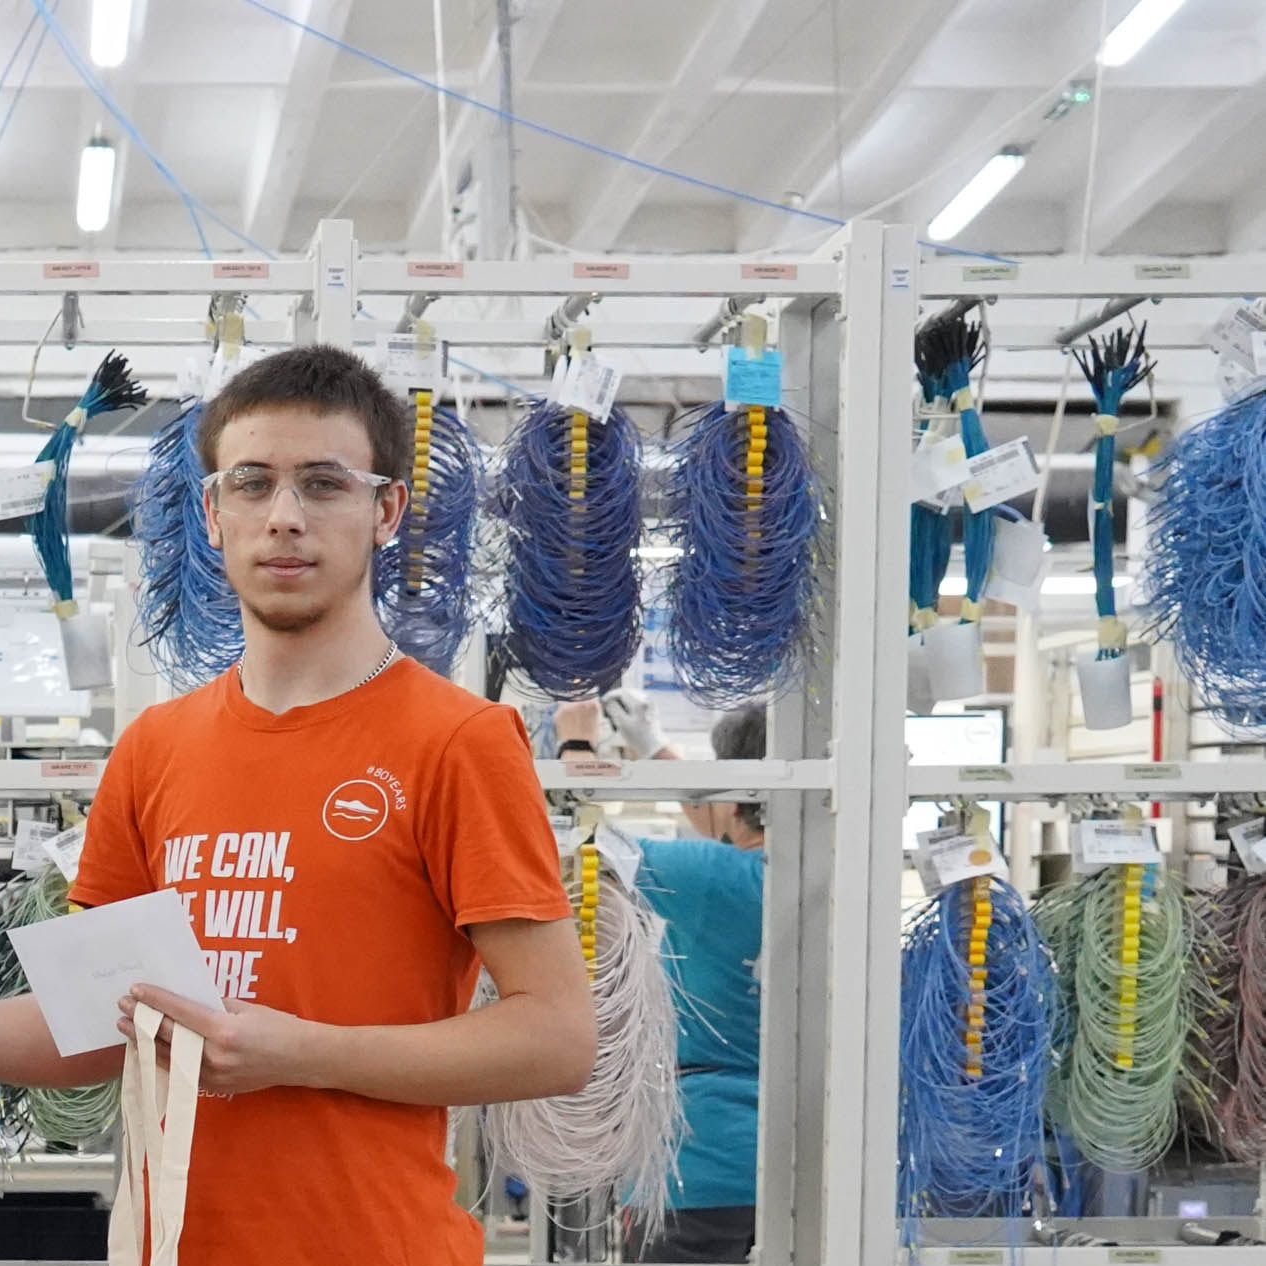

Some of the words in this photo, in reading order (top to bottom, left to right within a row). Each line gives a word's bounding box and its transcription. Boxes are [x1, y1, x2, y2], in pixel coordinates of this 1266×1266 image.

[366, 765, 407, 810] #80YEARS
[163, 834, 209, 884] WE
[211, 831, 295, 882] CAN,
[204, 890, 298, 944] WILL,
